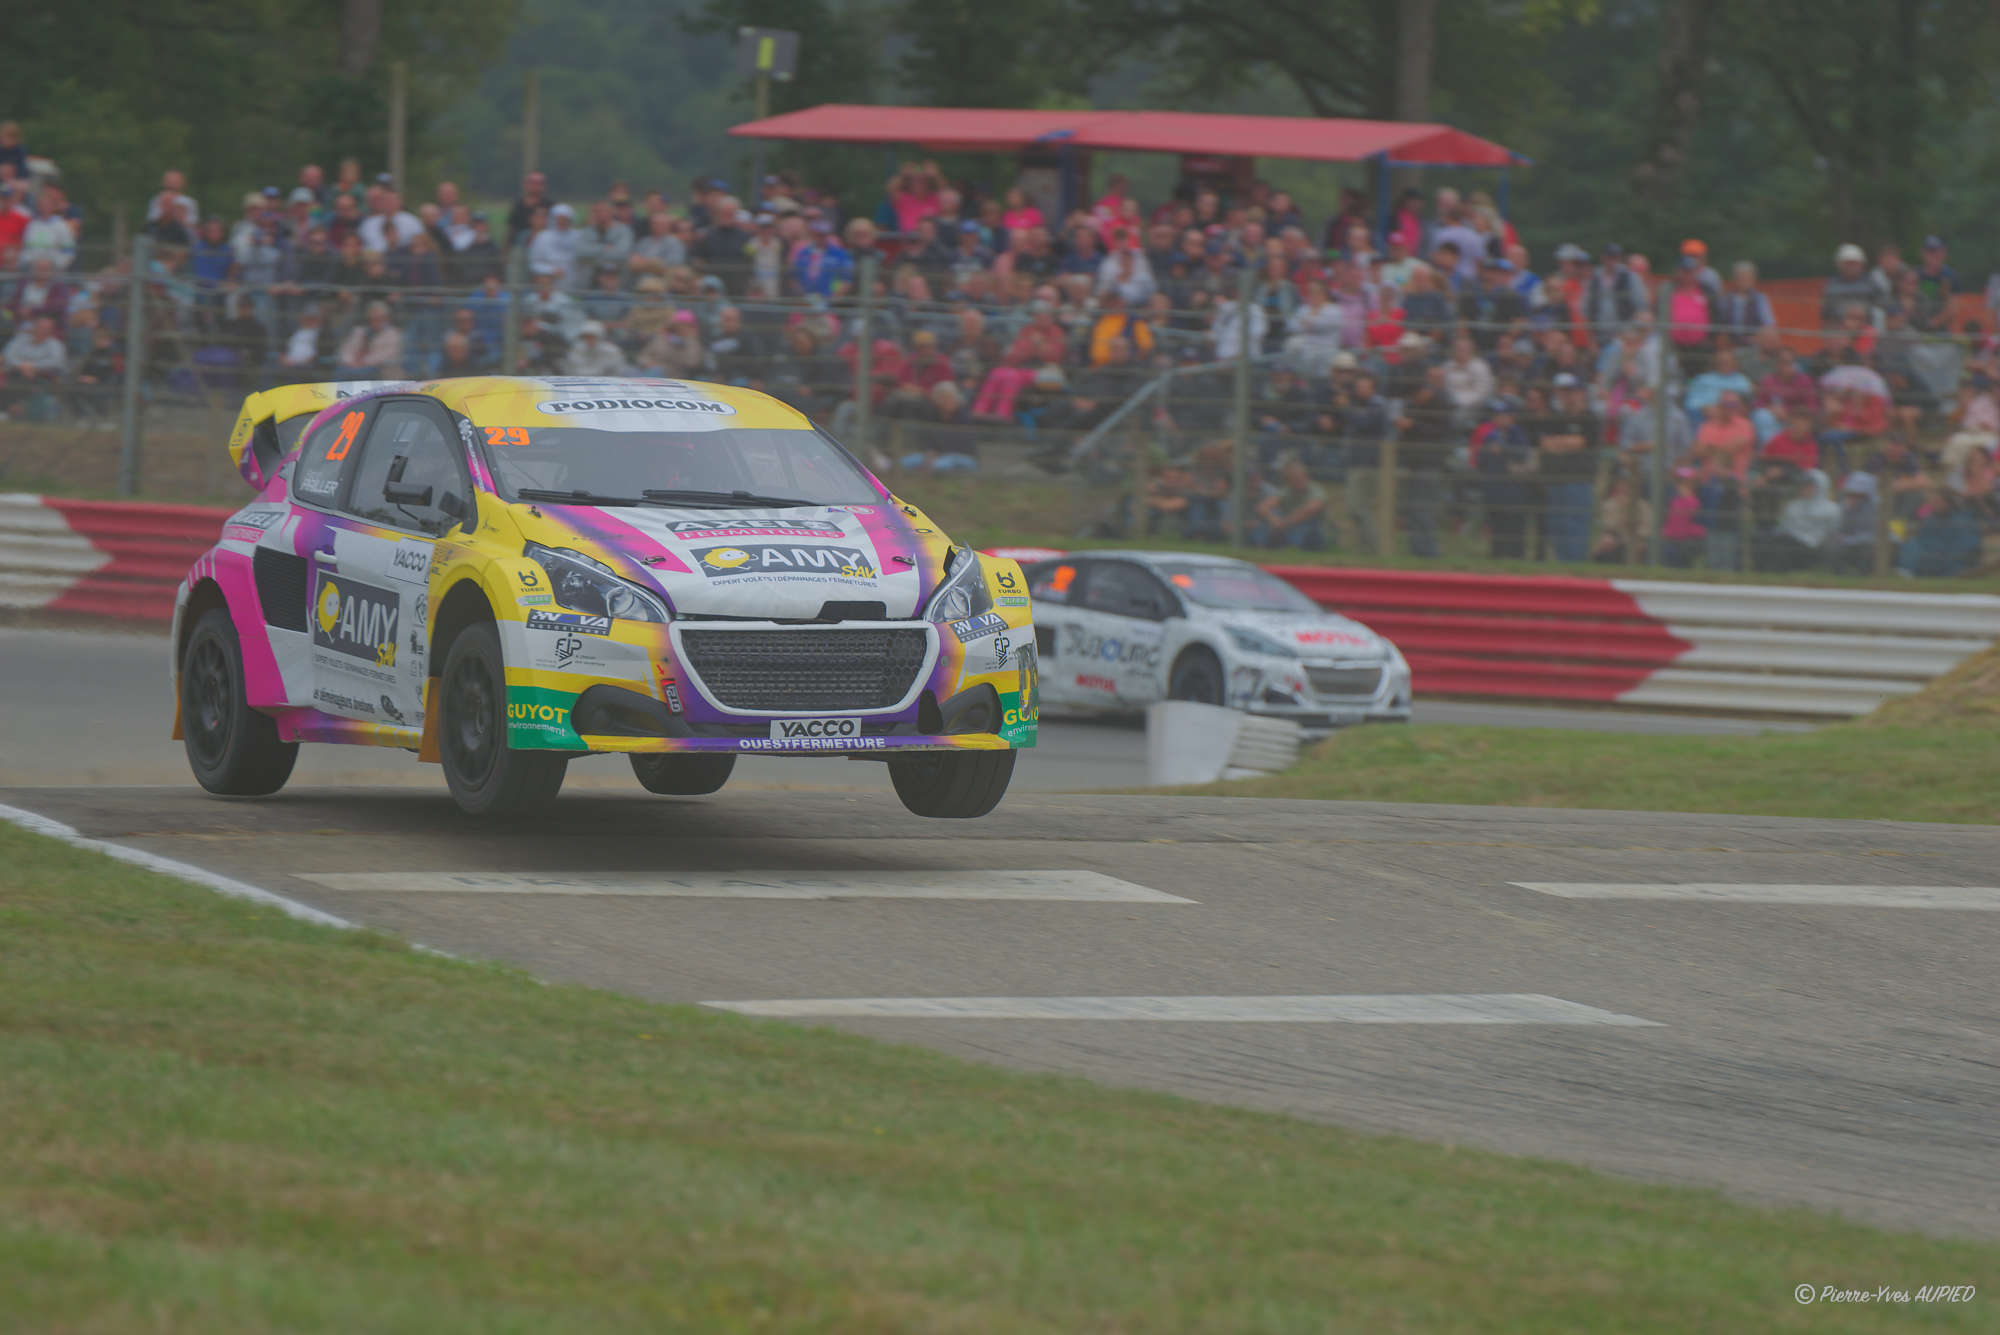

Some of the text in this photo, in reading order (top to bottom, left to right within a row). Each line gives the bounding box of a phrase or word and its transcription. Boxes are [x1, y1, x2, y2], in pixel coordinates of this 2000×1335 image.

[549, 399, 726, 413] PODIOCOM
[325, 411, 365, 461] 29
[484, 427, 530, 446] 29
[393, 548, 427, 572] YACCO
[762, 548, 860, 569] AMY
[840, 564, 878, 579] SAV
[340, 595, 397, 651] AMY
[507, 703, 569, 724] GUYOT
[779, 720, 855, 738] YACCO
[739, 738, 886, 750] OUESTFERMETURE
